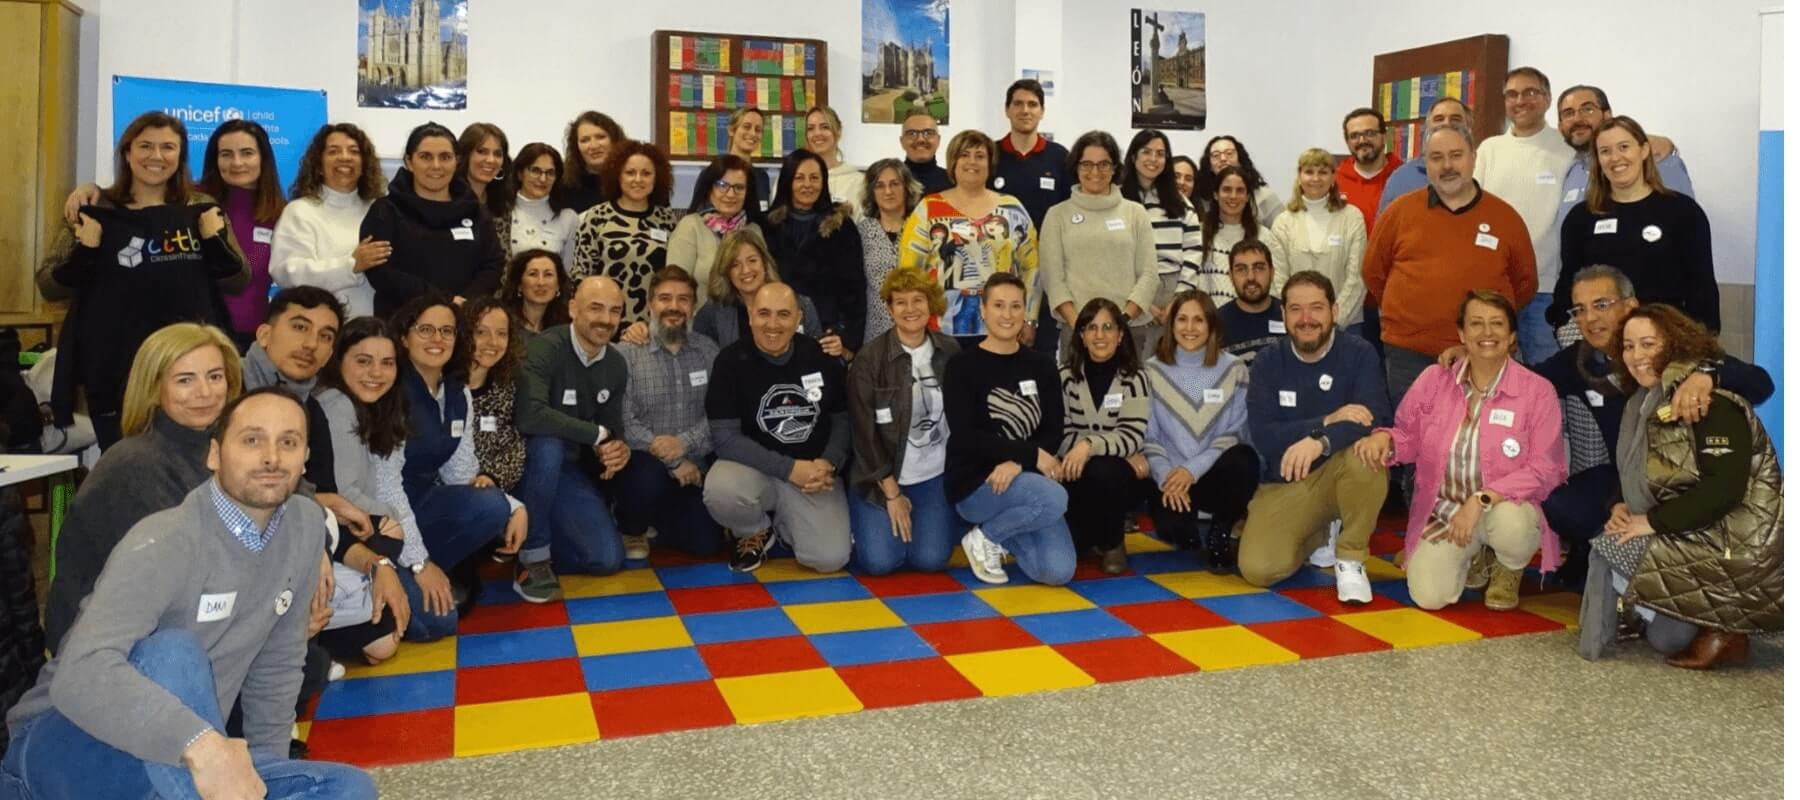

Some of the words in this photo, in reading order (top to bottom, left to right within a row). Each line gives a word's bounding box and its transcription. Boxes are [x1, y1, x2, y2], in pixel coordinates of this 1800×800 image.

[1132, 12, 1141, 113] LEÓN
[164, 104, 221, 122] unicef
[251, 112, 275, 121] child
[147, 227, 200, 254] citb
